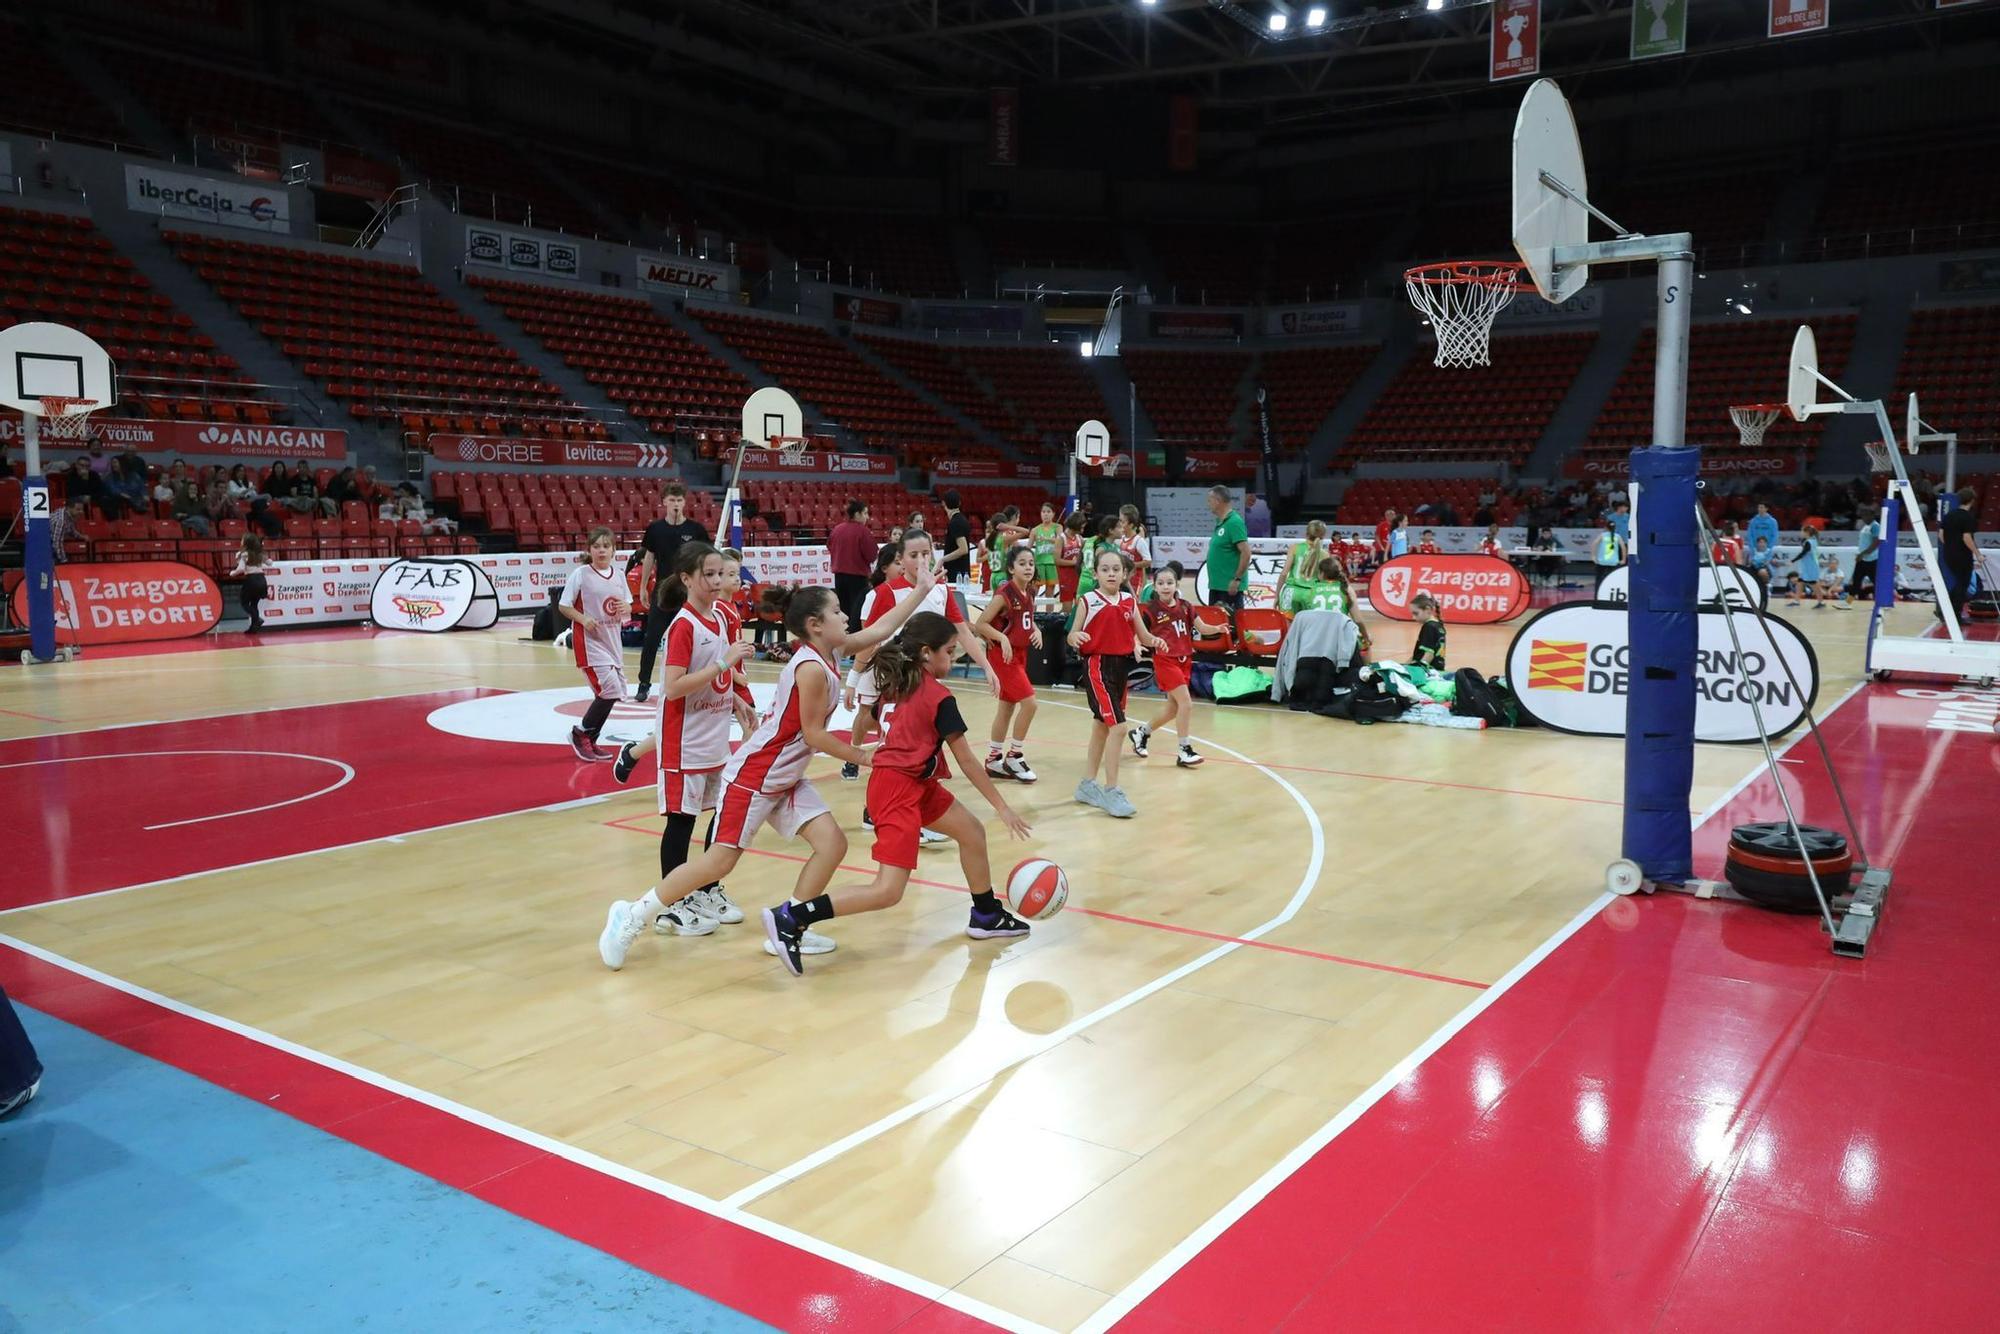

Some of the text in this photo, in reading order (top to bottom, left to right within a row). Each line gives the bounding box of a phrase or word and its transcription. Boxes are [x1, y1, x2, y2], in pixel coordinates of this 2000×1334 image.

[139, 178, 233, 213] iberCaja
[1664, 286, 1679, 304] S
[1301, 310, 1346, 323] Zaragoza
[105, 429, 154, 442] VOLUM
[230, 428, 325, 449] ANAGAN
[479, 443, 544, 462] ORBE
[565, 444, 613, 461] levitec
[1699, 458, 1785, 471] LEJANDRO
[32, 492, 47, 511] 2
[338, 582, 371, 590] Zaragoza
[395, 565, 463, 591] FAB
[494, 574, 522, 582] Zaragoza
[1418, 567, 1511, 591] Zaragoza
[84, 578, 207, 604] Zaragoza
[278, 585, 313, 594] Zaragoza
[278, 592, 313, 600] DEPORTE
[338, 589, 371, 597] DEPORTE
[90, 605, 214, 629] DEPORTE
[1021, 611, 1031, 630] 6
[1171, 619, 1186, 638] 14
